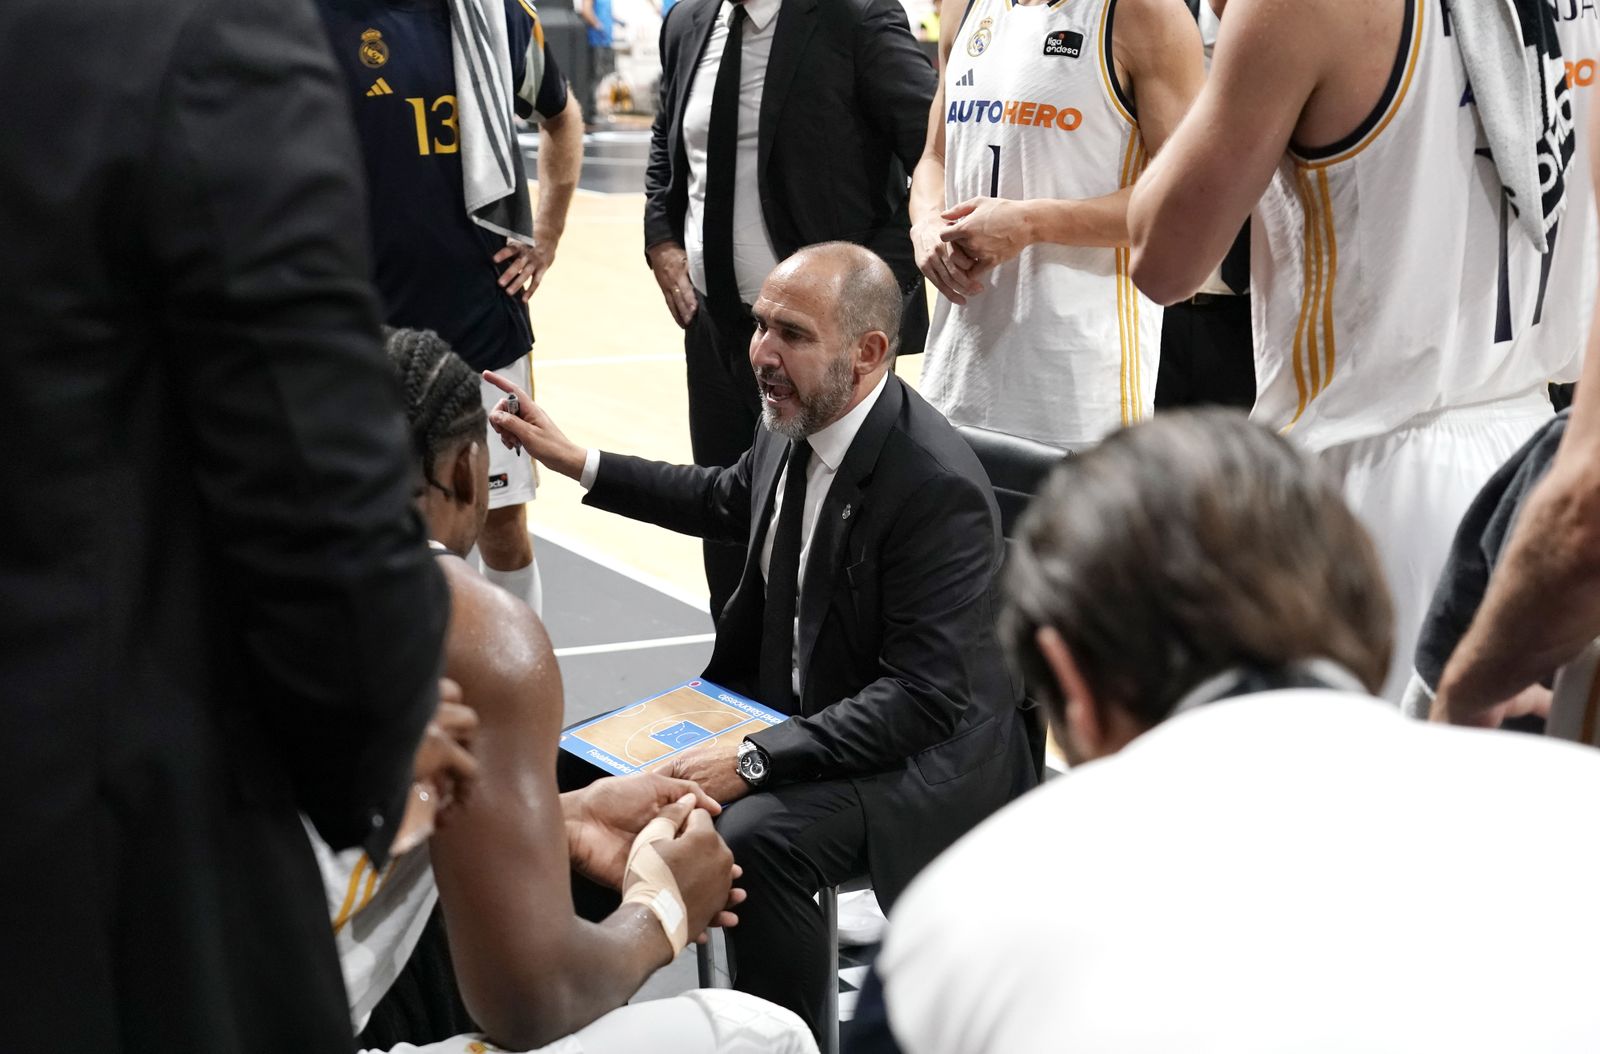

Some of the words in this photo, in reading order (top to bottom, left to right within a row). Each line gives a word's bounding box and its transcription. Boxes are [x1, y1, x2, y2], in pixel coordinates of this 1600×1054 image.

[1046, 45, 1079, 55] endesa
[1047, 37, 1062, 47] liga
[404, 95, 459, 156] 13
[946, 100, 1083, 131] AUTOHERO
